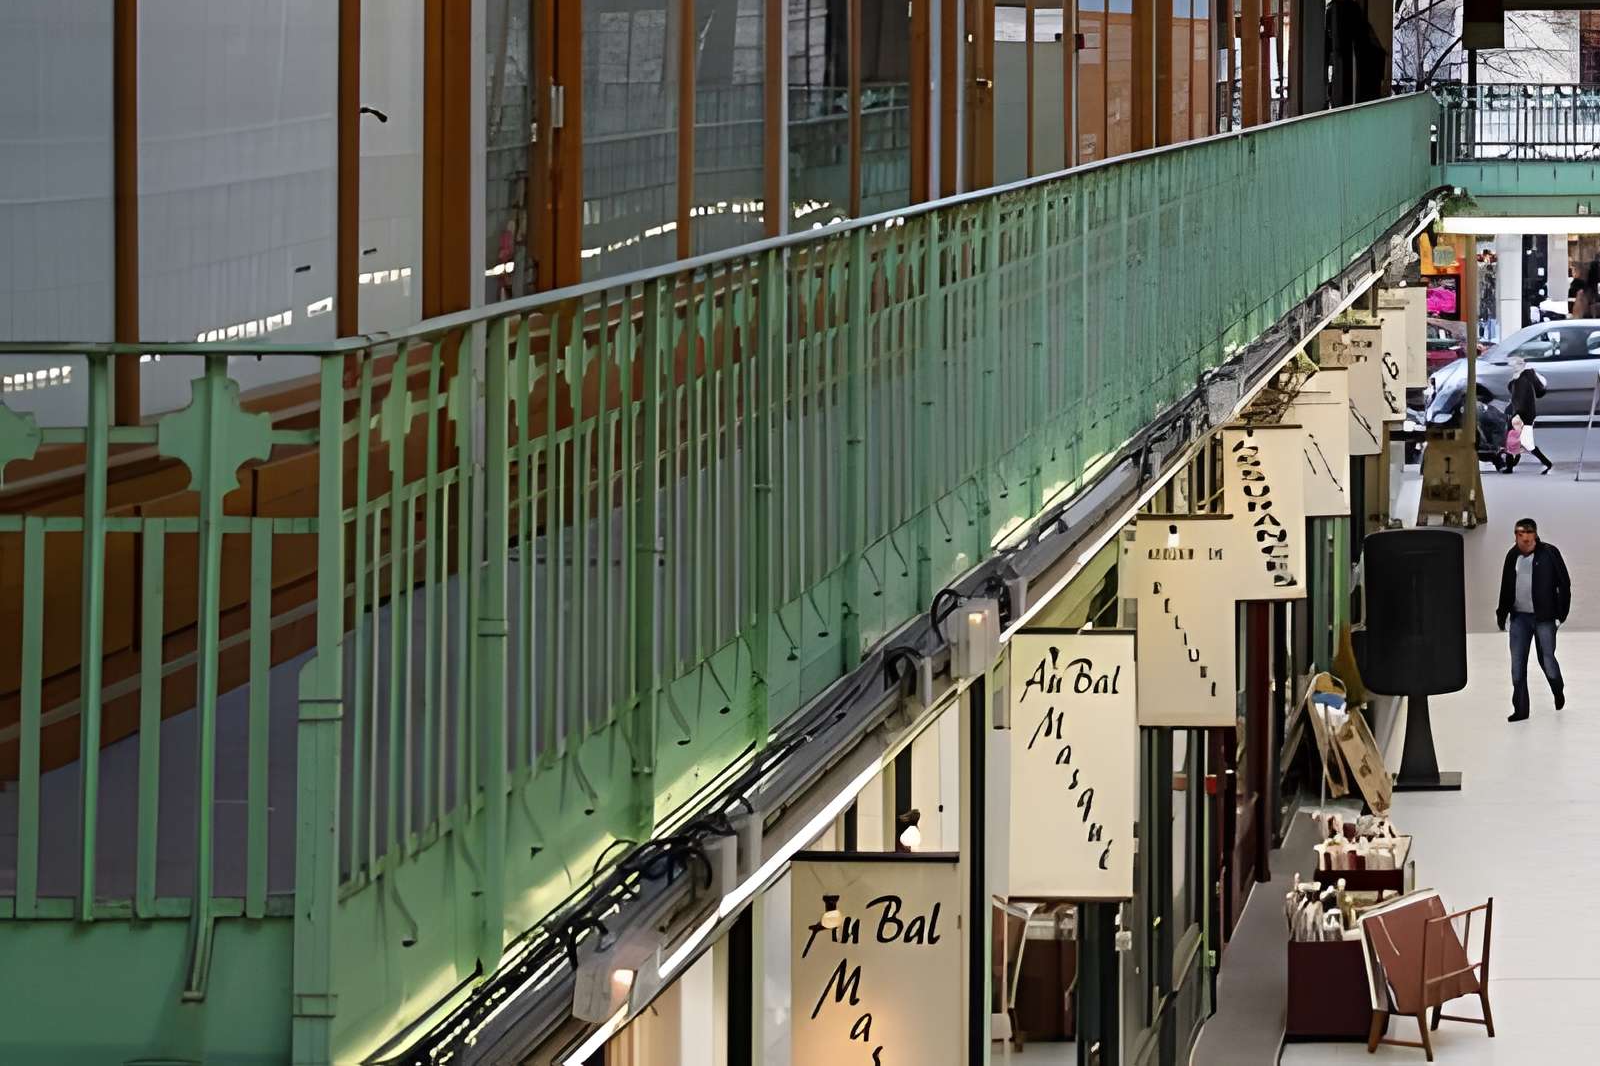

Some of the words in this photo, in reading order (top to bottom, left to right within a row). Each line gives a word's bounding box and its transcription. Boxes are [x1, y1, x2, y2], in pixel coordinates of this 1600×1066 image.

[1020, 658, 1063, 703] Au
[1066, 658, 1121, 694] Bal
[866, 895, 941, 945] Bal
